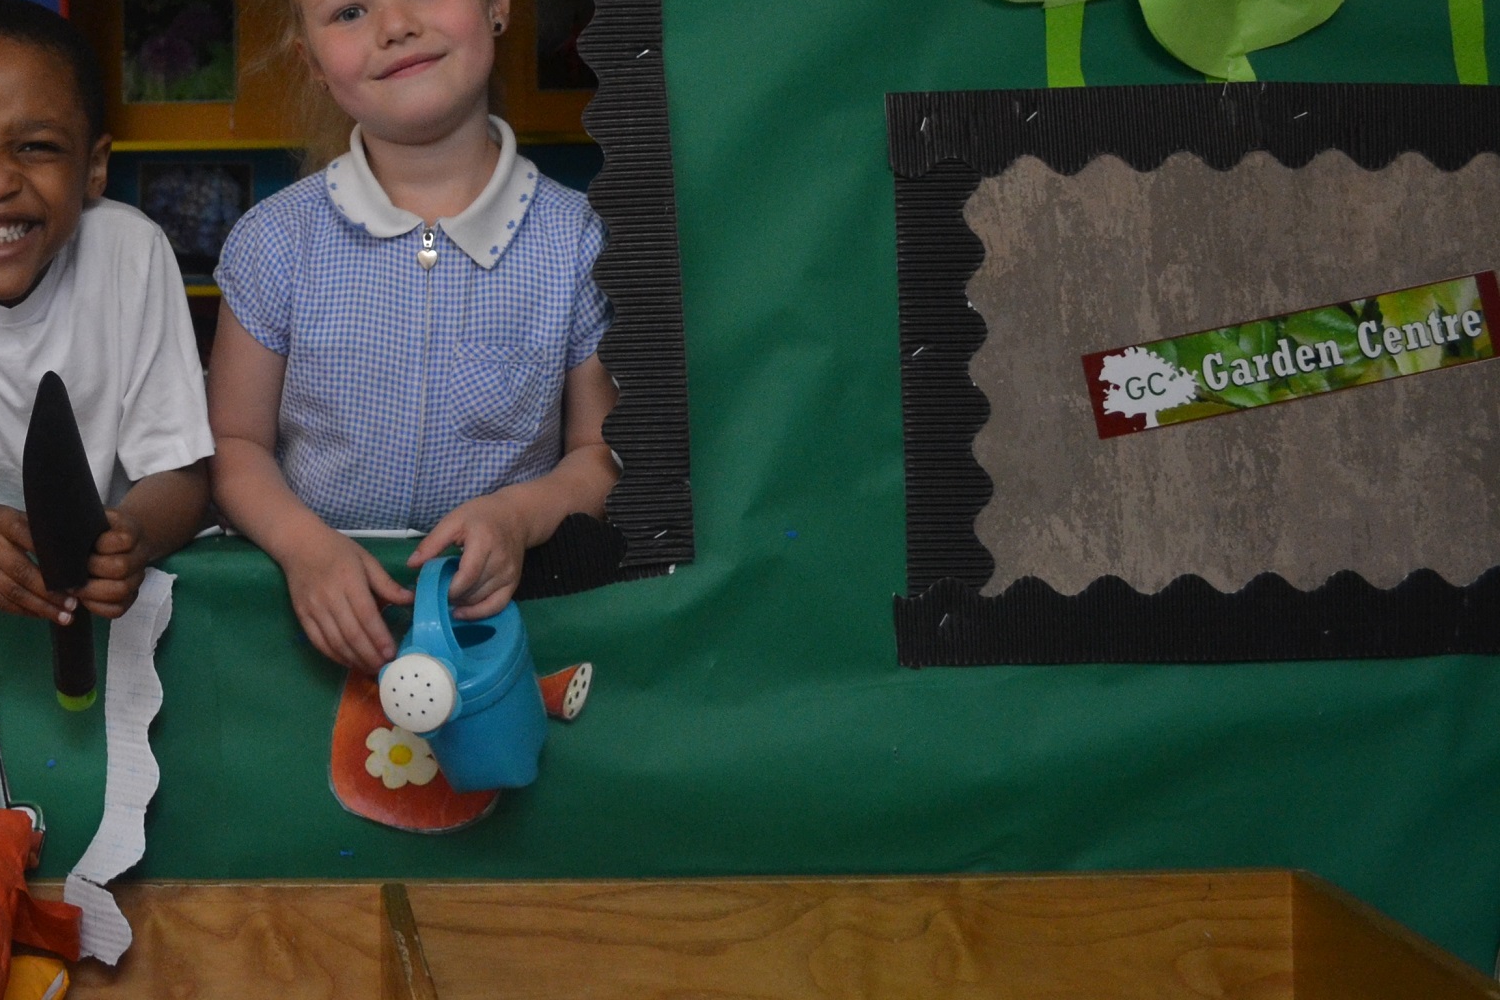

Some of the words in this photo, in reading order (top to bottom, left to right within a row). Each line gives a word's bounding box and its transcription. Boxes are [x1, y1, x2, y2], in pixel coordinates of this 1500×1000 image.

[1202, 338, 1345, 393] Garden
[1357, 308, 1483, 360] Centre
[1124, 371, 1167, 401] GC
